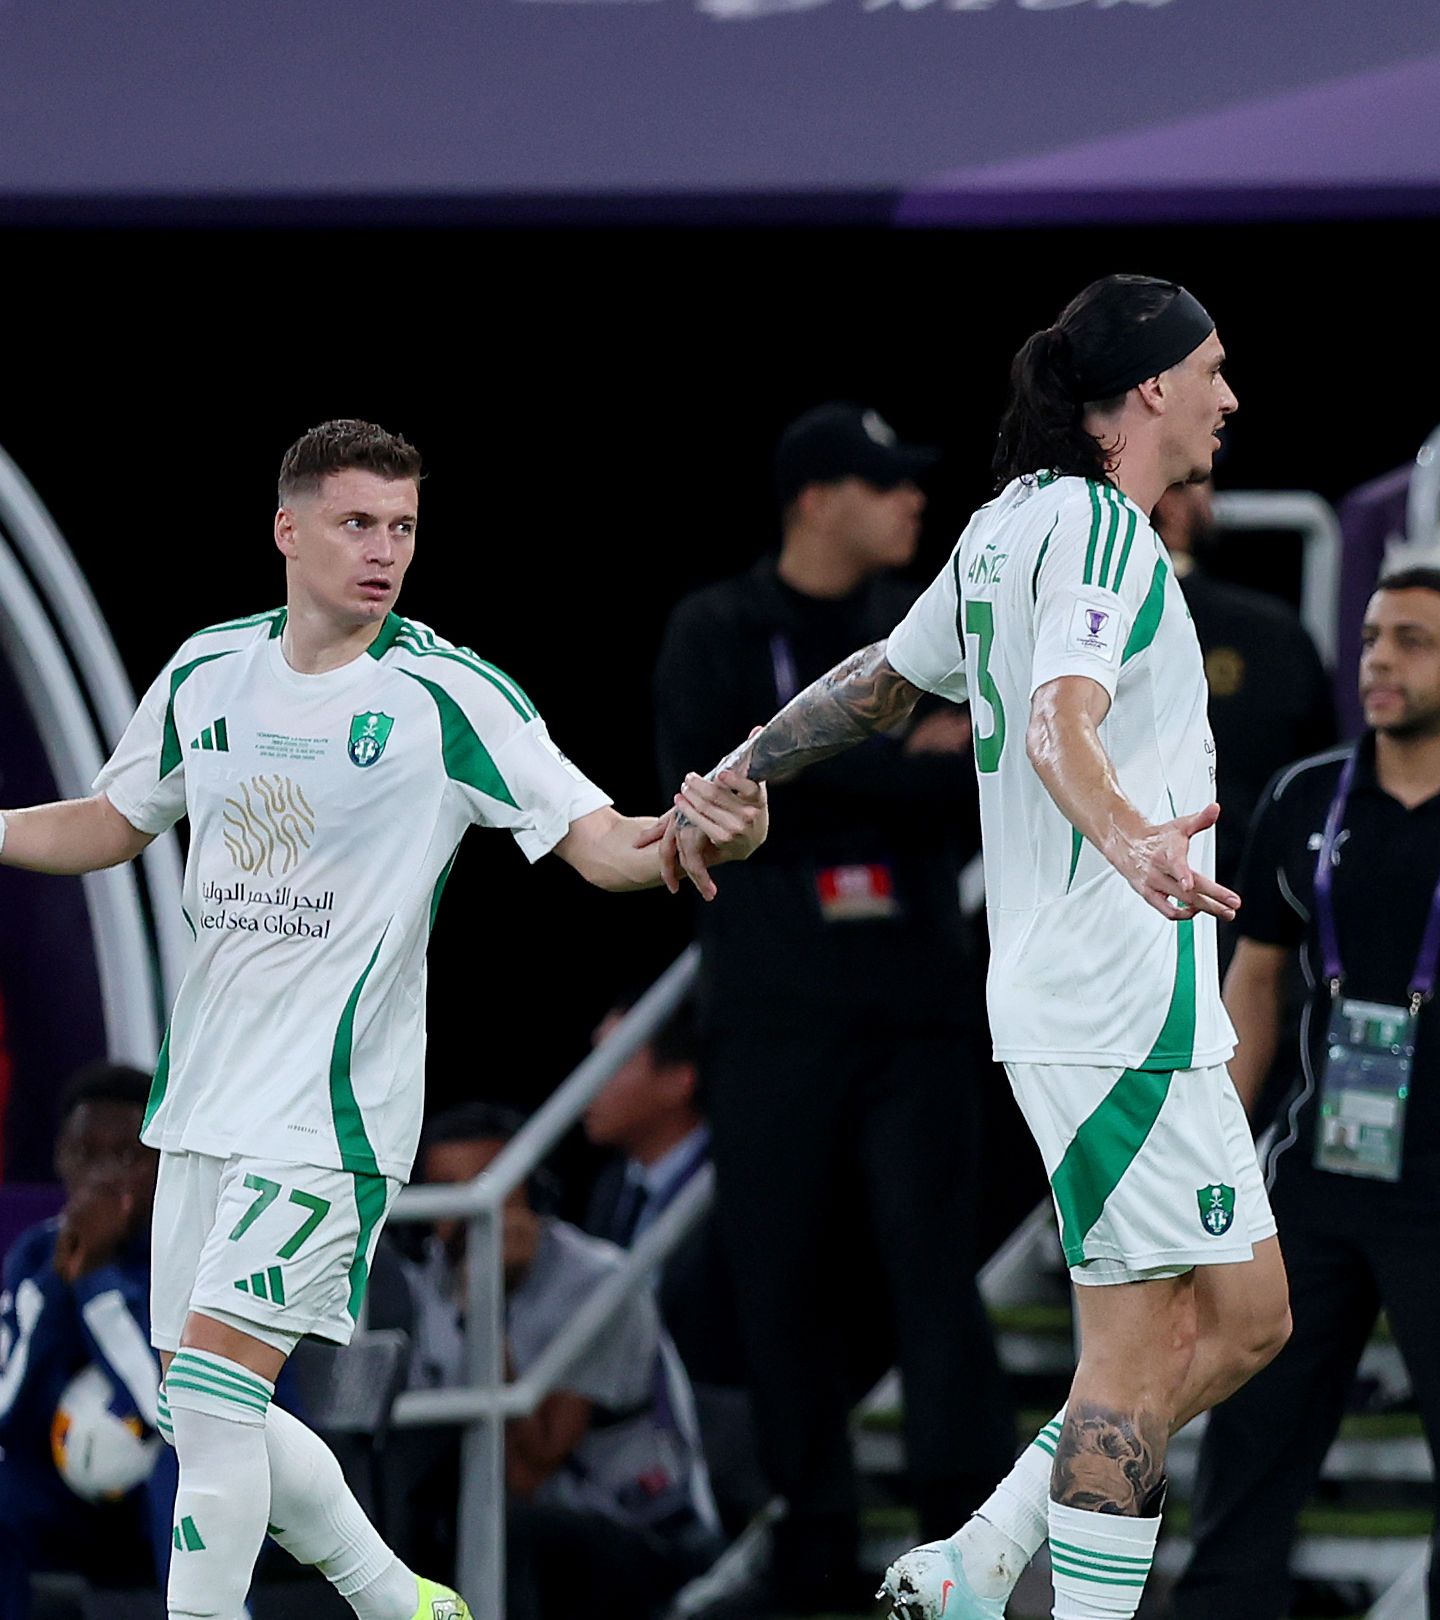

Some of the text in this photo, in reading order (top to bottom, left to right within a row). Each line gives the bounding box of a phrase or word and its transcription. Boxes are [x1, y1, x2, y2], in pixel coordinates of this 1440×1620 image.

[966, 600, 1006, 773] 3
[200, 909, 331, 939] ed Sea Global
[228, 1172, 332, 1260] 77
